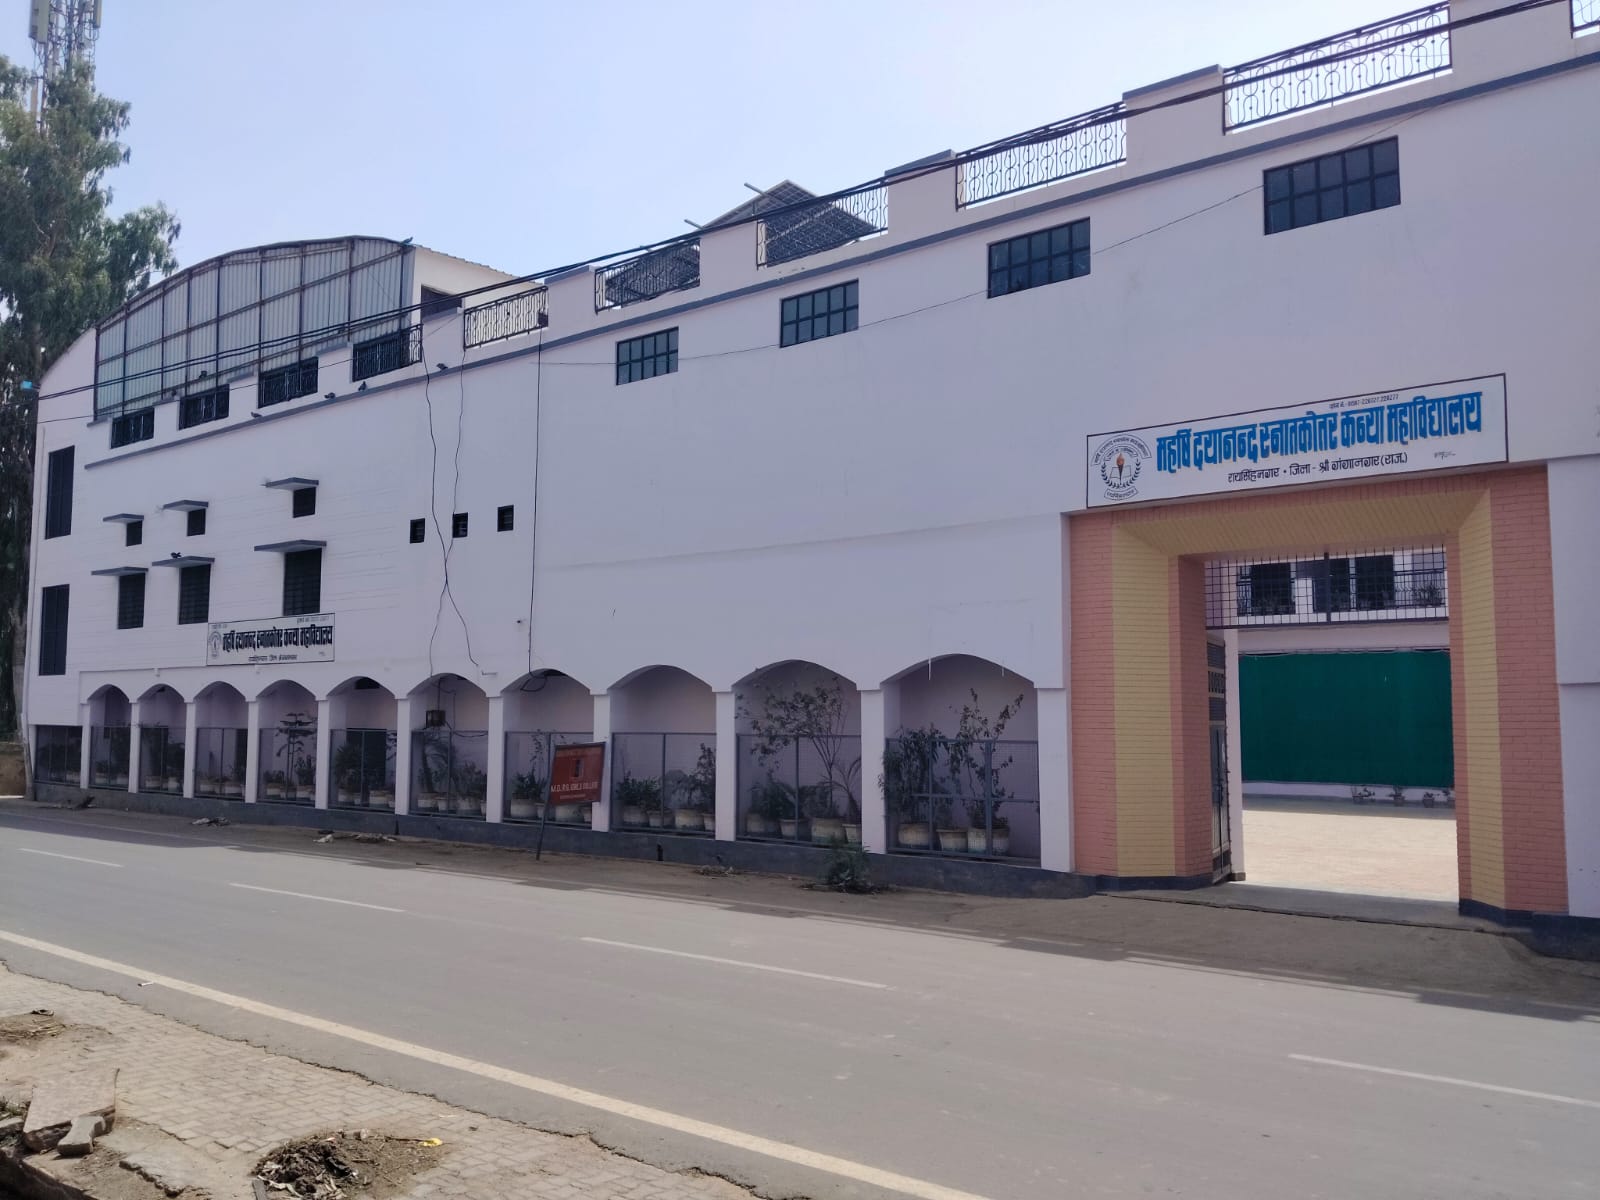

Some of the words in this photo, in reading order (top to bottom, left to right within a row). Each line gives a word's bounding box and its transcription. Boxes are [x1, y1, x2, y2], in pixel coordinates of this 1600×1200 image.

[1156, 428, 1192, 474] महर्षि
[1193, 424, 1258, 471] दयानन्द
[1340, 405, 1385, 448] कन्या
[1386, 391, 1483, 445] महाविद्यालय
[1289, 463, 1311, 476] जिला
